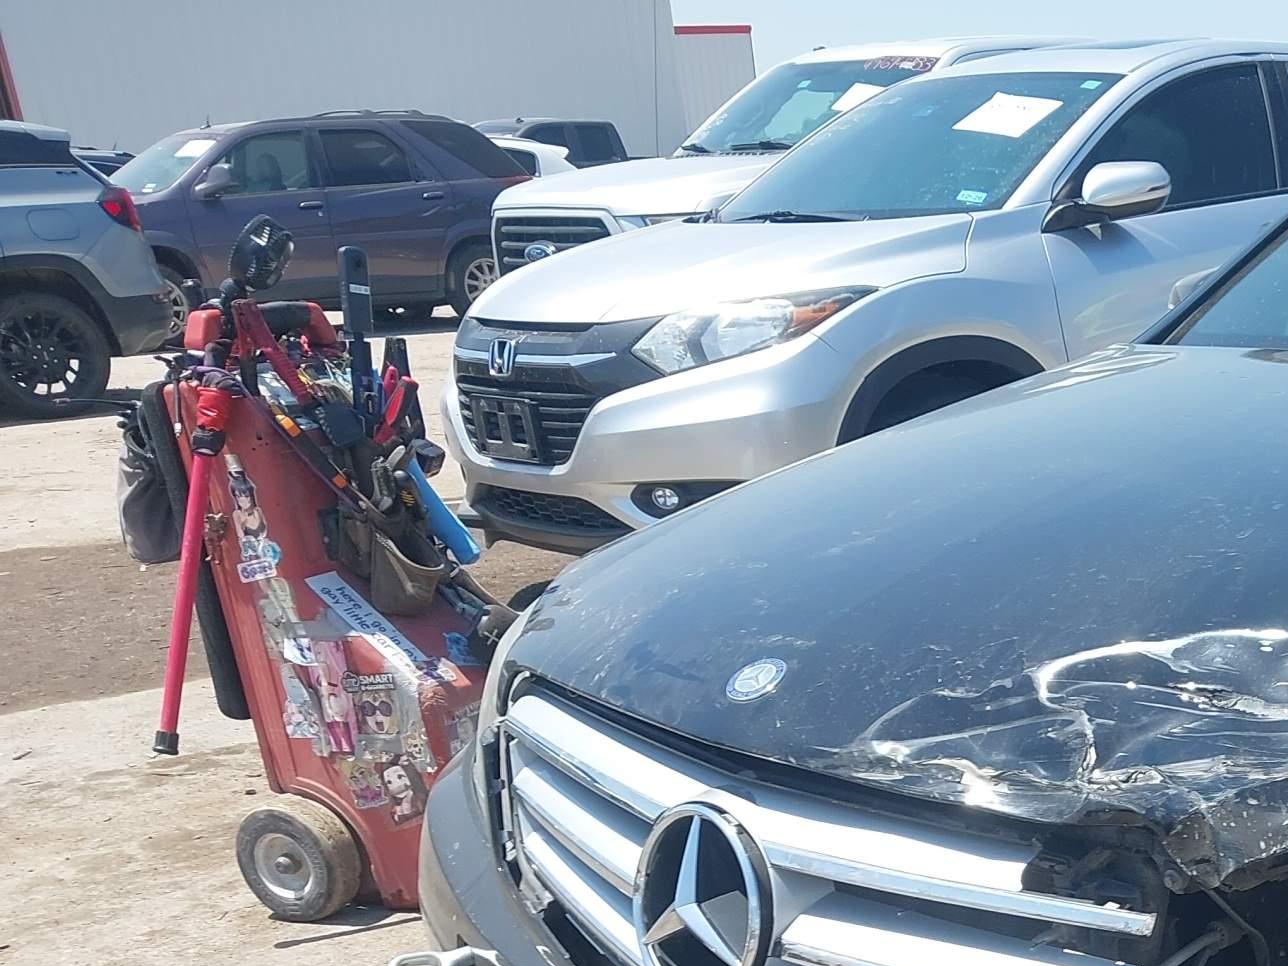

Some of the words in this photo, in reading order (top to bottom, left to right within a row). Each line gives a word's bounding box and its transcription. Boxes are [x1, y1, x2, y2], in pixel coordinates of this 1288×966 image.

[320, 587, 343, 605] gay
[344, 607, 371, 630] little
[335, 586, 362, 611] here
[371, 620, 387, 634] go
[359, 673, 393, 685] SMART
